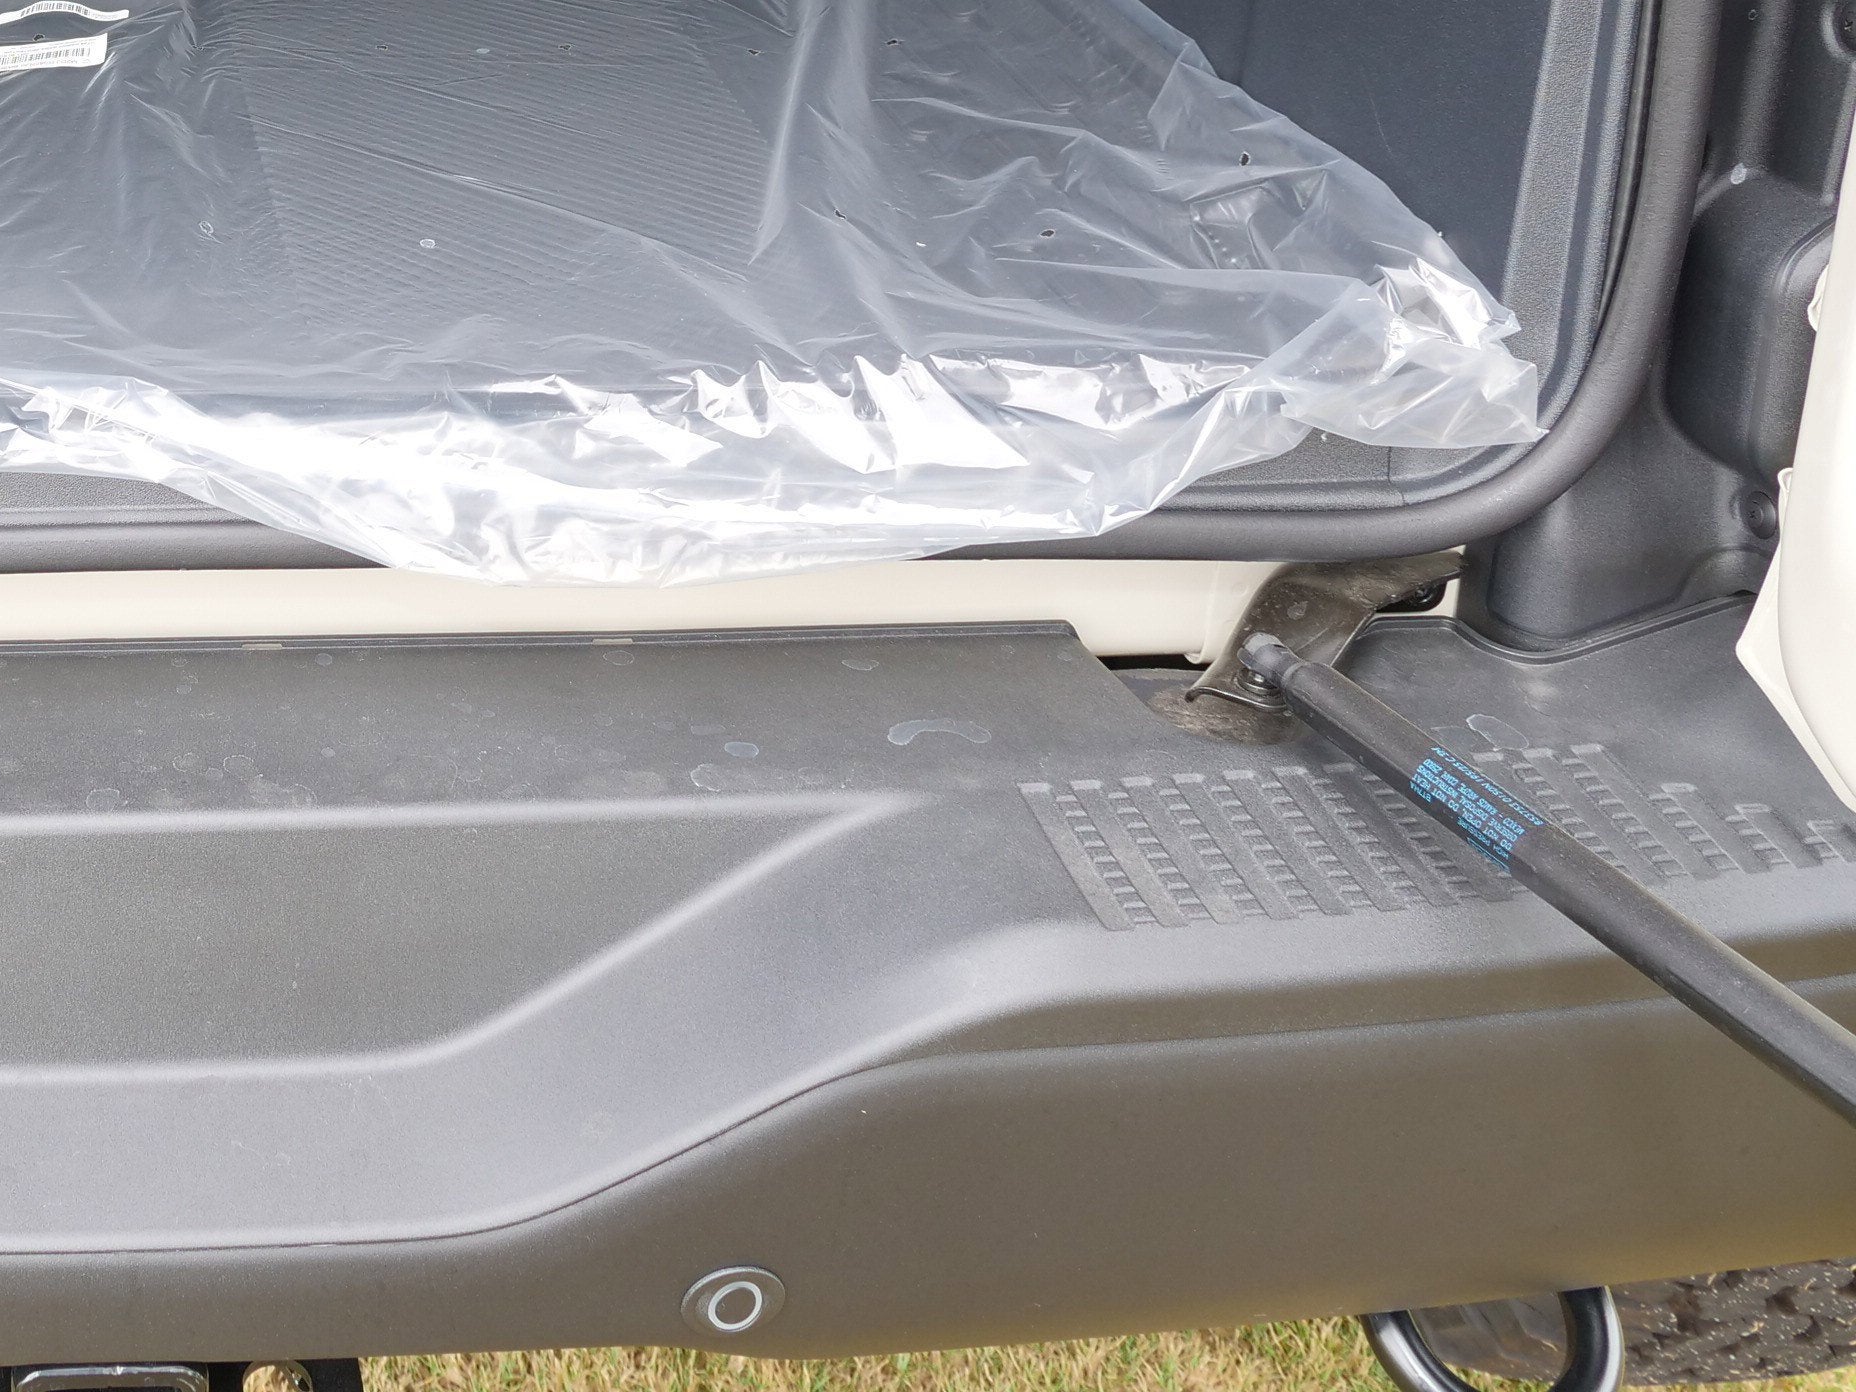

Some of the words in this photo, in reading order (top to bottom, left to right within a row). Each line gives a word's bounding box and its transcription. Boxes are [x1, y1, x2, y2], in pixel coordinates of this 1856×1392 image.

[1412, 773, 1431, 789] HEAT
[1416, 765, 1458, 798] INSTRUCTIONS
[1431, 788, 1447, 801] NOT
[1459, 796, 1489, 820] DISPOSAL
[1482, 827, 1499, 839] NOT
[1488, 817, 1518, 841] OBSERVE
